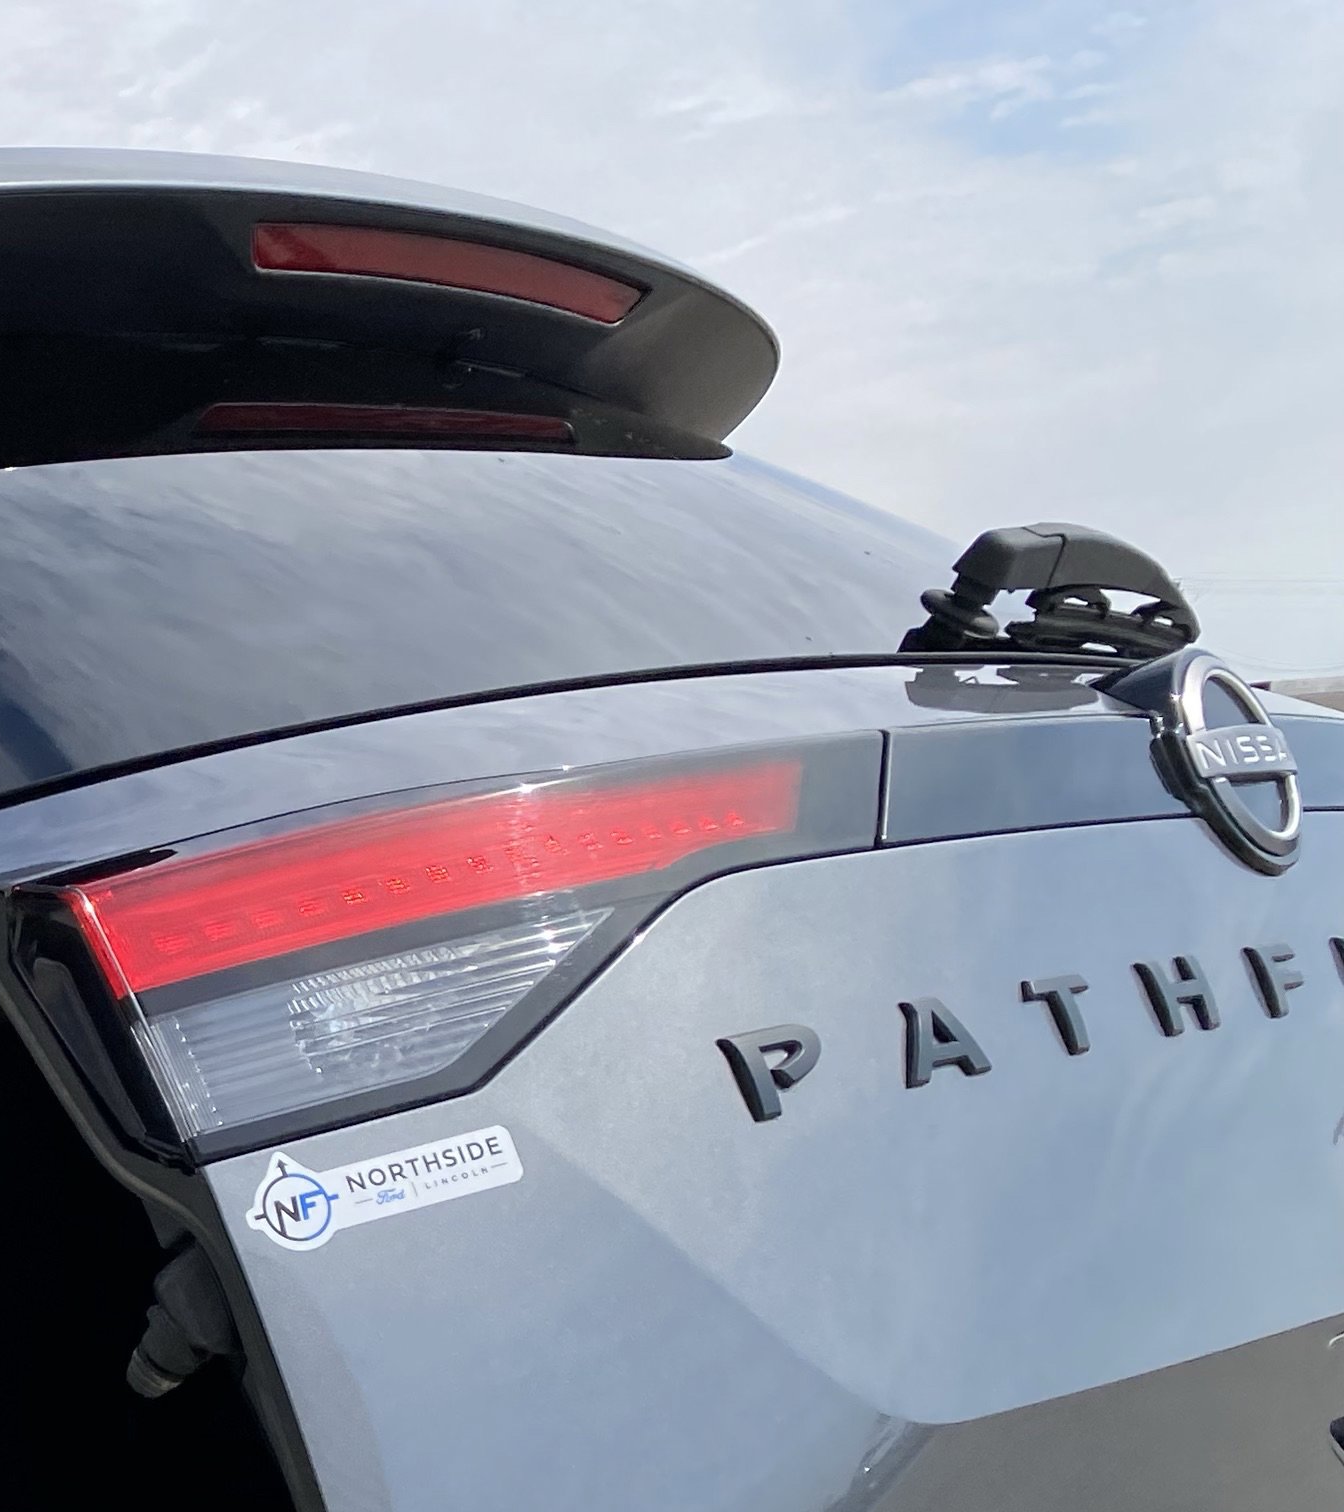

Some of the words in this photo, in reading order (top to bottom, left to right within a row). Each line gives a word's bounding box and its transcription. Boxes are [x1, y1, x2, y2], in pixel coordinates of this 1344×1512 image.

[716, 936, 1344, 1122] PATHF
[345, 1136, 503, 1193] NORTHSIDE
[376, 1188, 406, 1205] Ford
[424, 1167, 489, 1190] LINCOLN
[273, 1188, 325, 1236] NF
